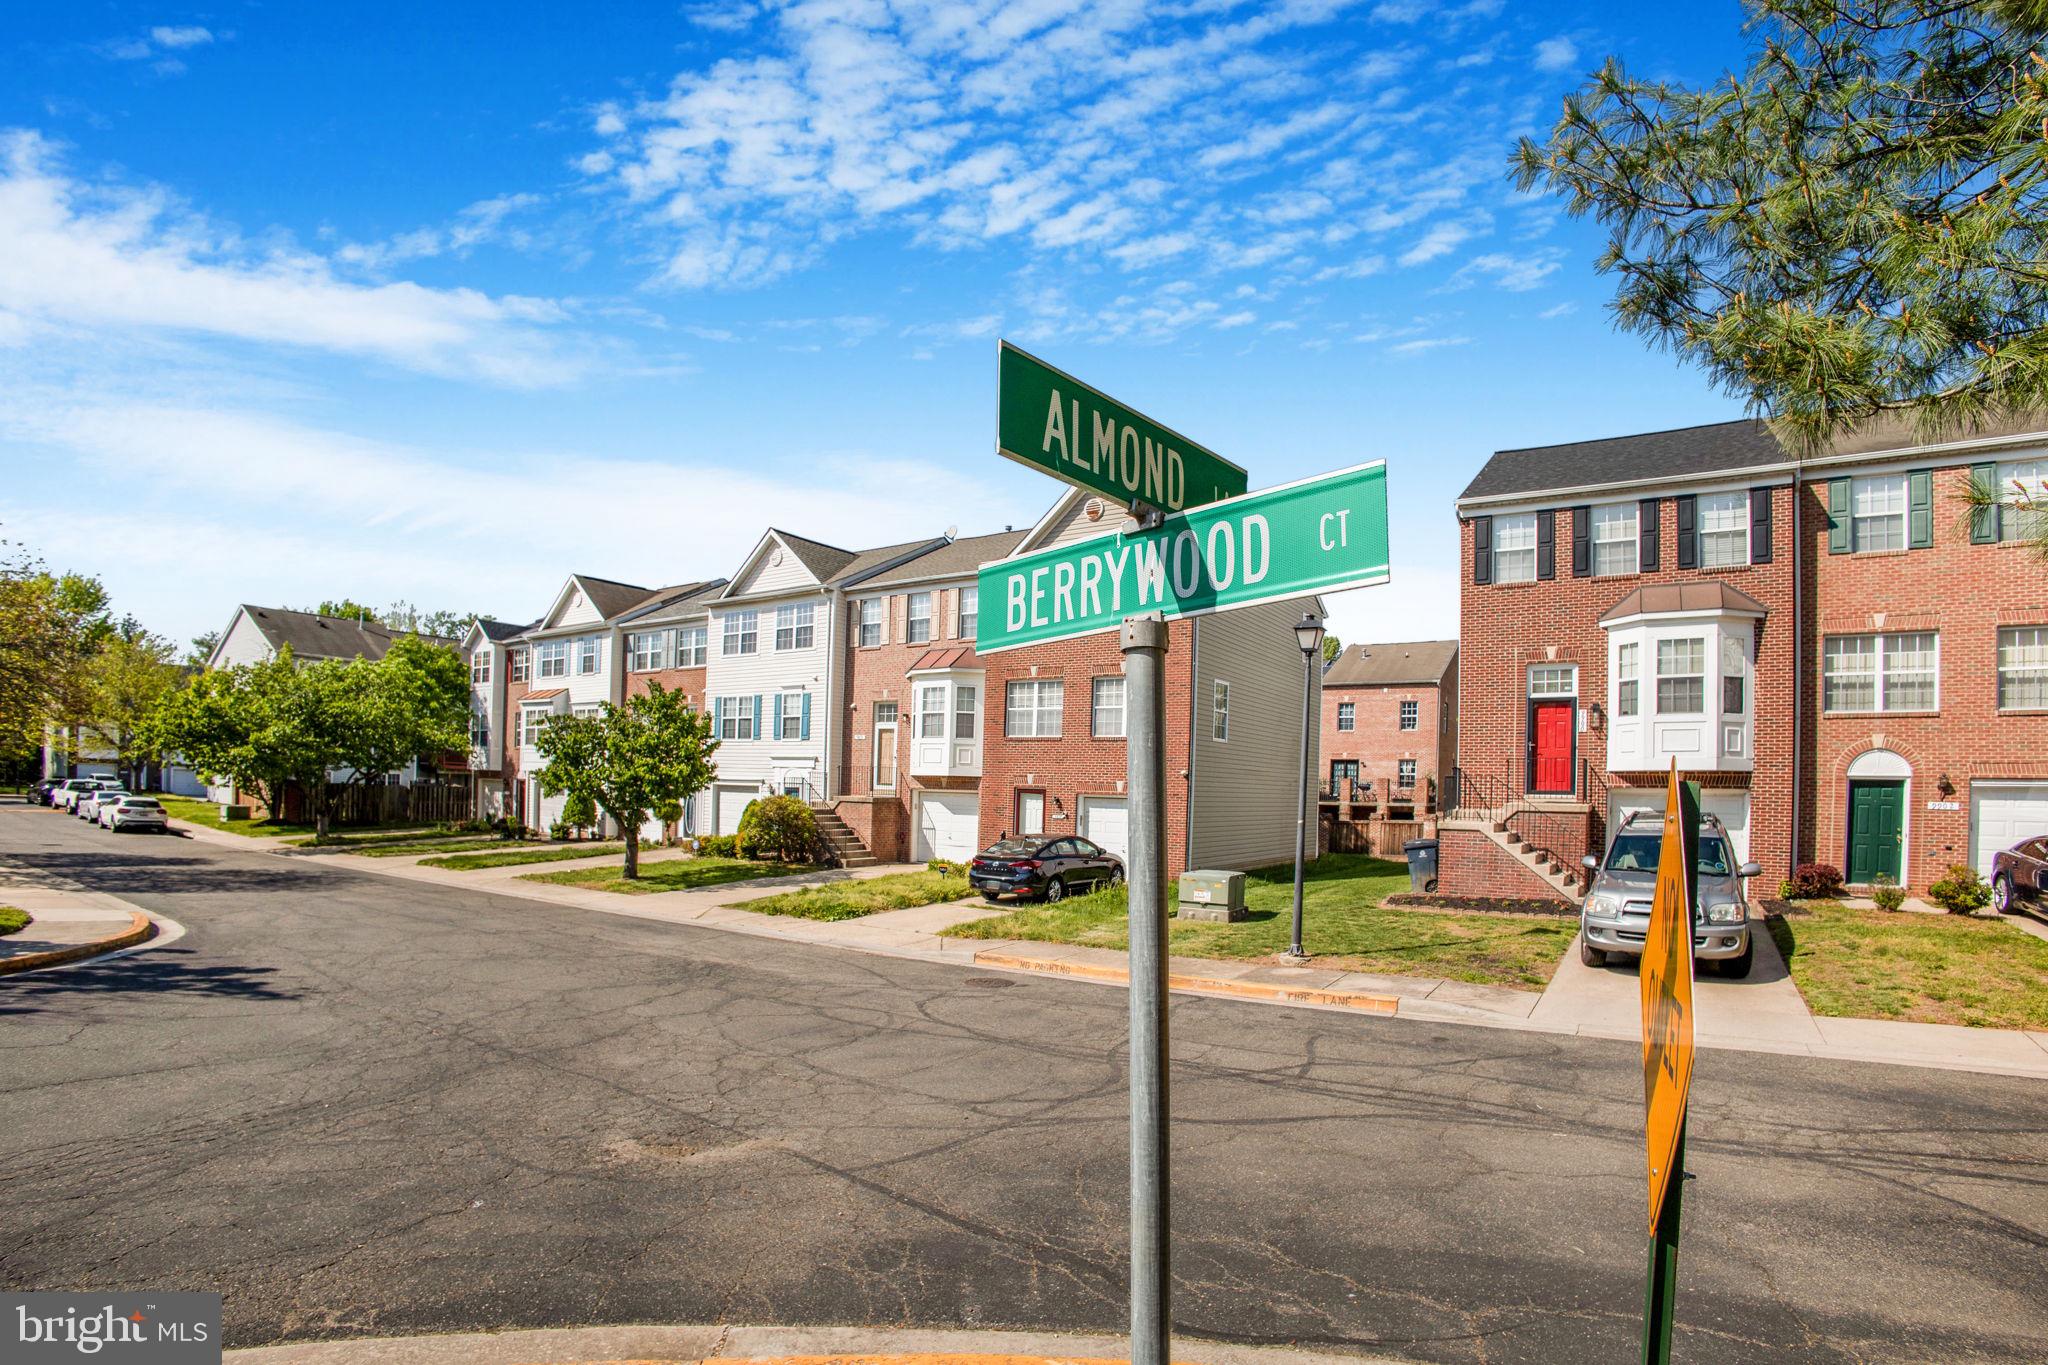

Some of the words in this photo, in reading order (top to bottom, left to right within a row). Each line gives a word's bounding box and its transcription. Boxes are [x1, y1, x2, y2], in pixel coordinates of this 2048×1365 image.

[1042, 388, 1184, 511] ALMOND
[1006, 513, 1270, 633] BERRYWOOD
[1319, 509, 1350, 551] CT
